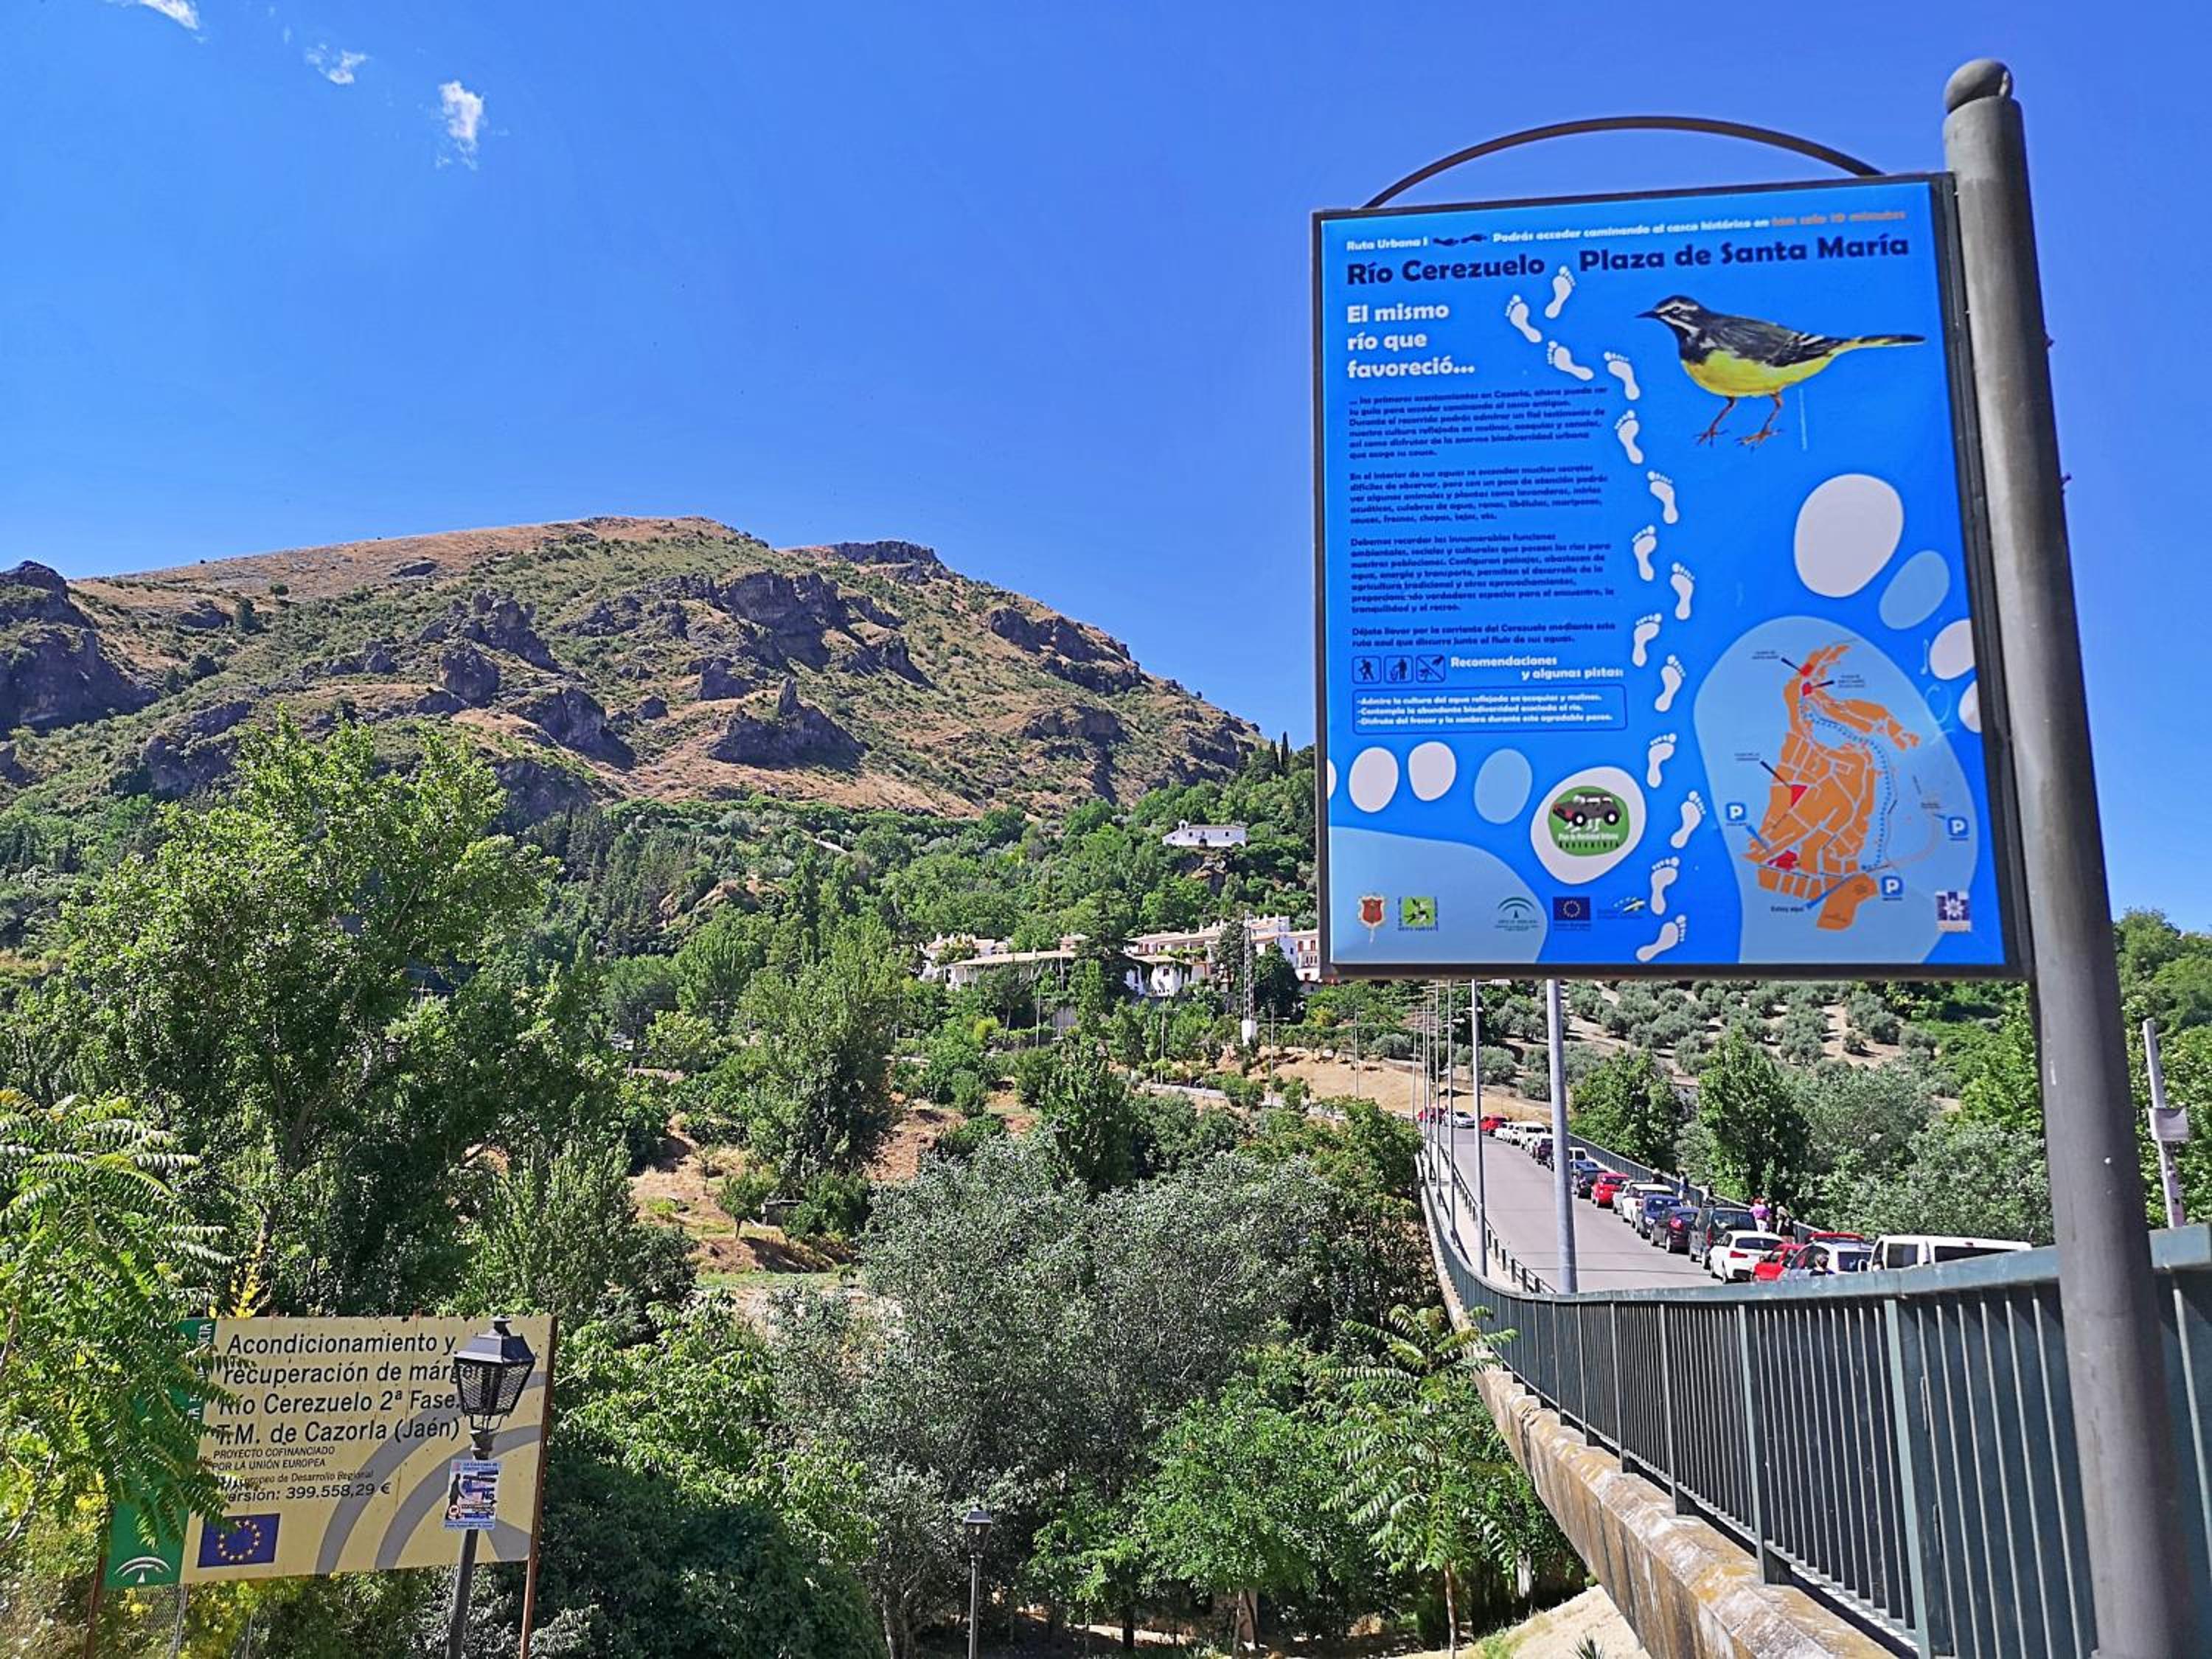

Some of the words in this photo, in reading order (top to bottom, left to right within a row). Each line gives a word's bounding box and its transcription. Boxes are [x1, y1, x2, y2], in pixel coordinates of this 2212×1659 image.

[1347, 262, 1393, 285] Río
[1402, 254, 1545, 282] Cerezuelo
[1579, 248, 1665, 271] Plaza
[1674, 244, 1711, 266] de
[1721, 240, 1806, 265] Santa
[1817, 233, 1909, 259] María
[1347, 305, 1368, 323] El
[1374, 303, 1449, 322] mismo
[1348, 333, 1378, 350] río
[1383, 333, 1427, 352] que
[1347, 356, 1475, 378] favoreció...
[1450, 655, 1557, 666] Recomendaciones
[1521, 670, 1530, 681] y
[1532, 667, 1581, 681] algunas
[226, 1333, 437, 1354] Acondicionamiento
[223, 1363, 368, 1388] recuperación
[377, 1362, 402, 1381] de
[220, 1394, 255, 1415] Río
[264, 1391, 372, 1414] Cerezuelo
[380, 1391, 402, 1411] 2ª
[409, 1390, 460, 1410] Fase.
[217, 1423, 260, 1445] T.M.
[271, 1422, 297, 1444] de
[305, 1420, 387, 1443] Cazorla
[394, 1417, 460, 1442] (Jaén)
[213, 1449, 263, 1459] PROYECTO
[265, 1446, 335, 1458] COFINANCIADO
[212, 1462, 232, 1471] POR
[234, 1461, 246, 1470] LA
[248, 1459, 279, 1470] UNIÓN
[282, 1458, 325, 1468] EUROPEA
[278, 1473, 288, 1482] de
[291, 1472, 335, 1482] Desarrollo
[337, 1469, 374, 1481] Regional
[285, 1484, 375, 1499] 399.558,29
[380, 1481, 392, 1495] €
